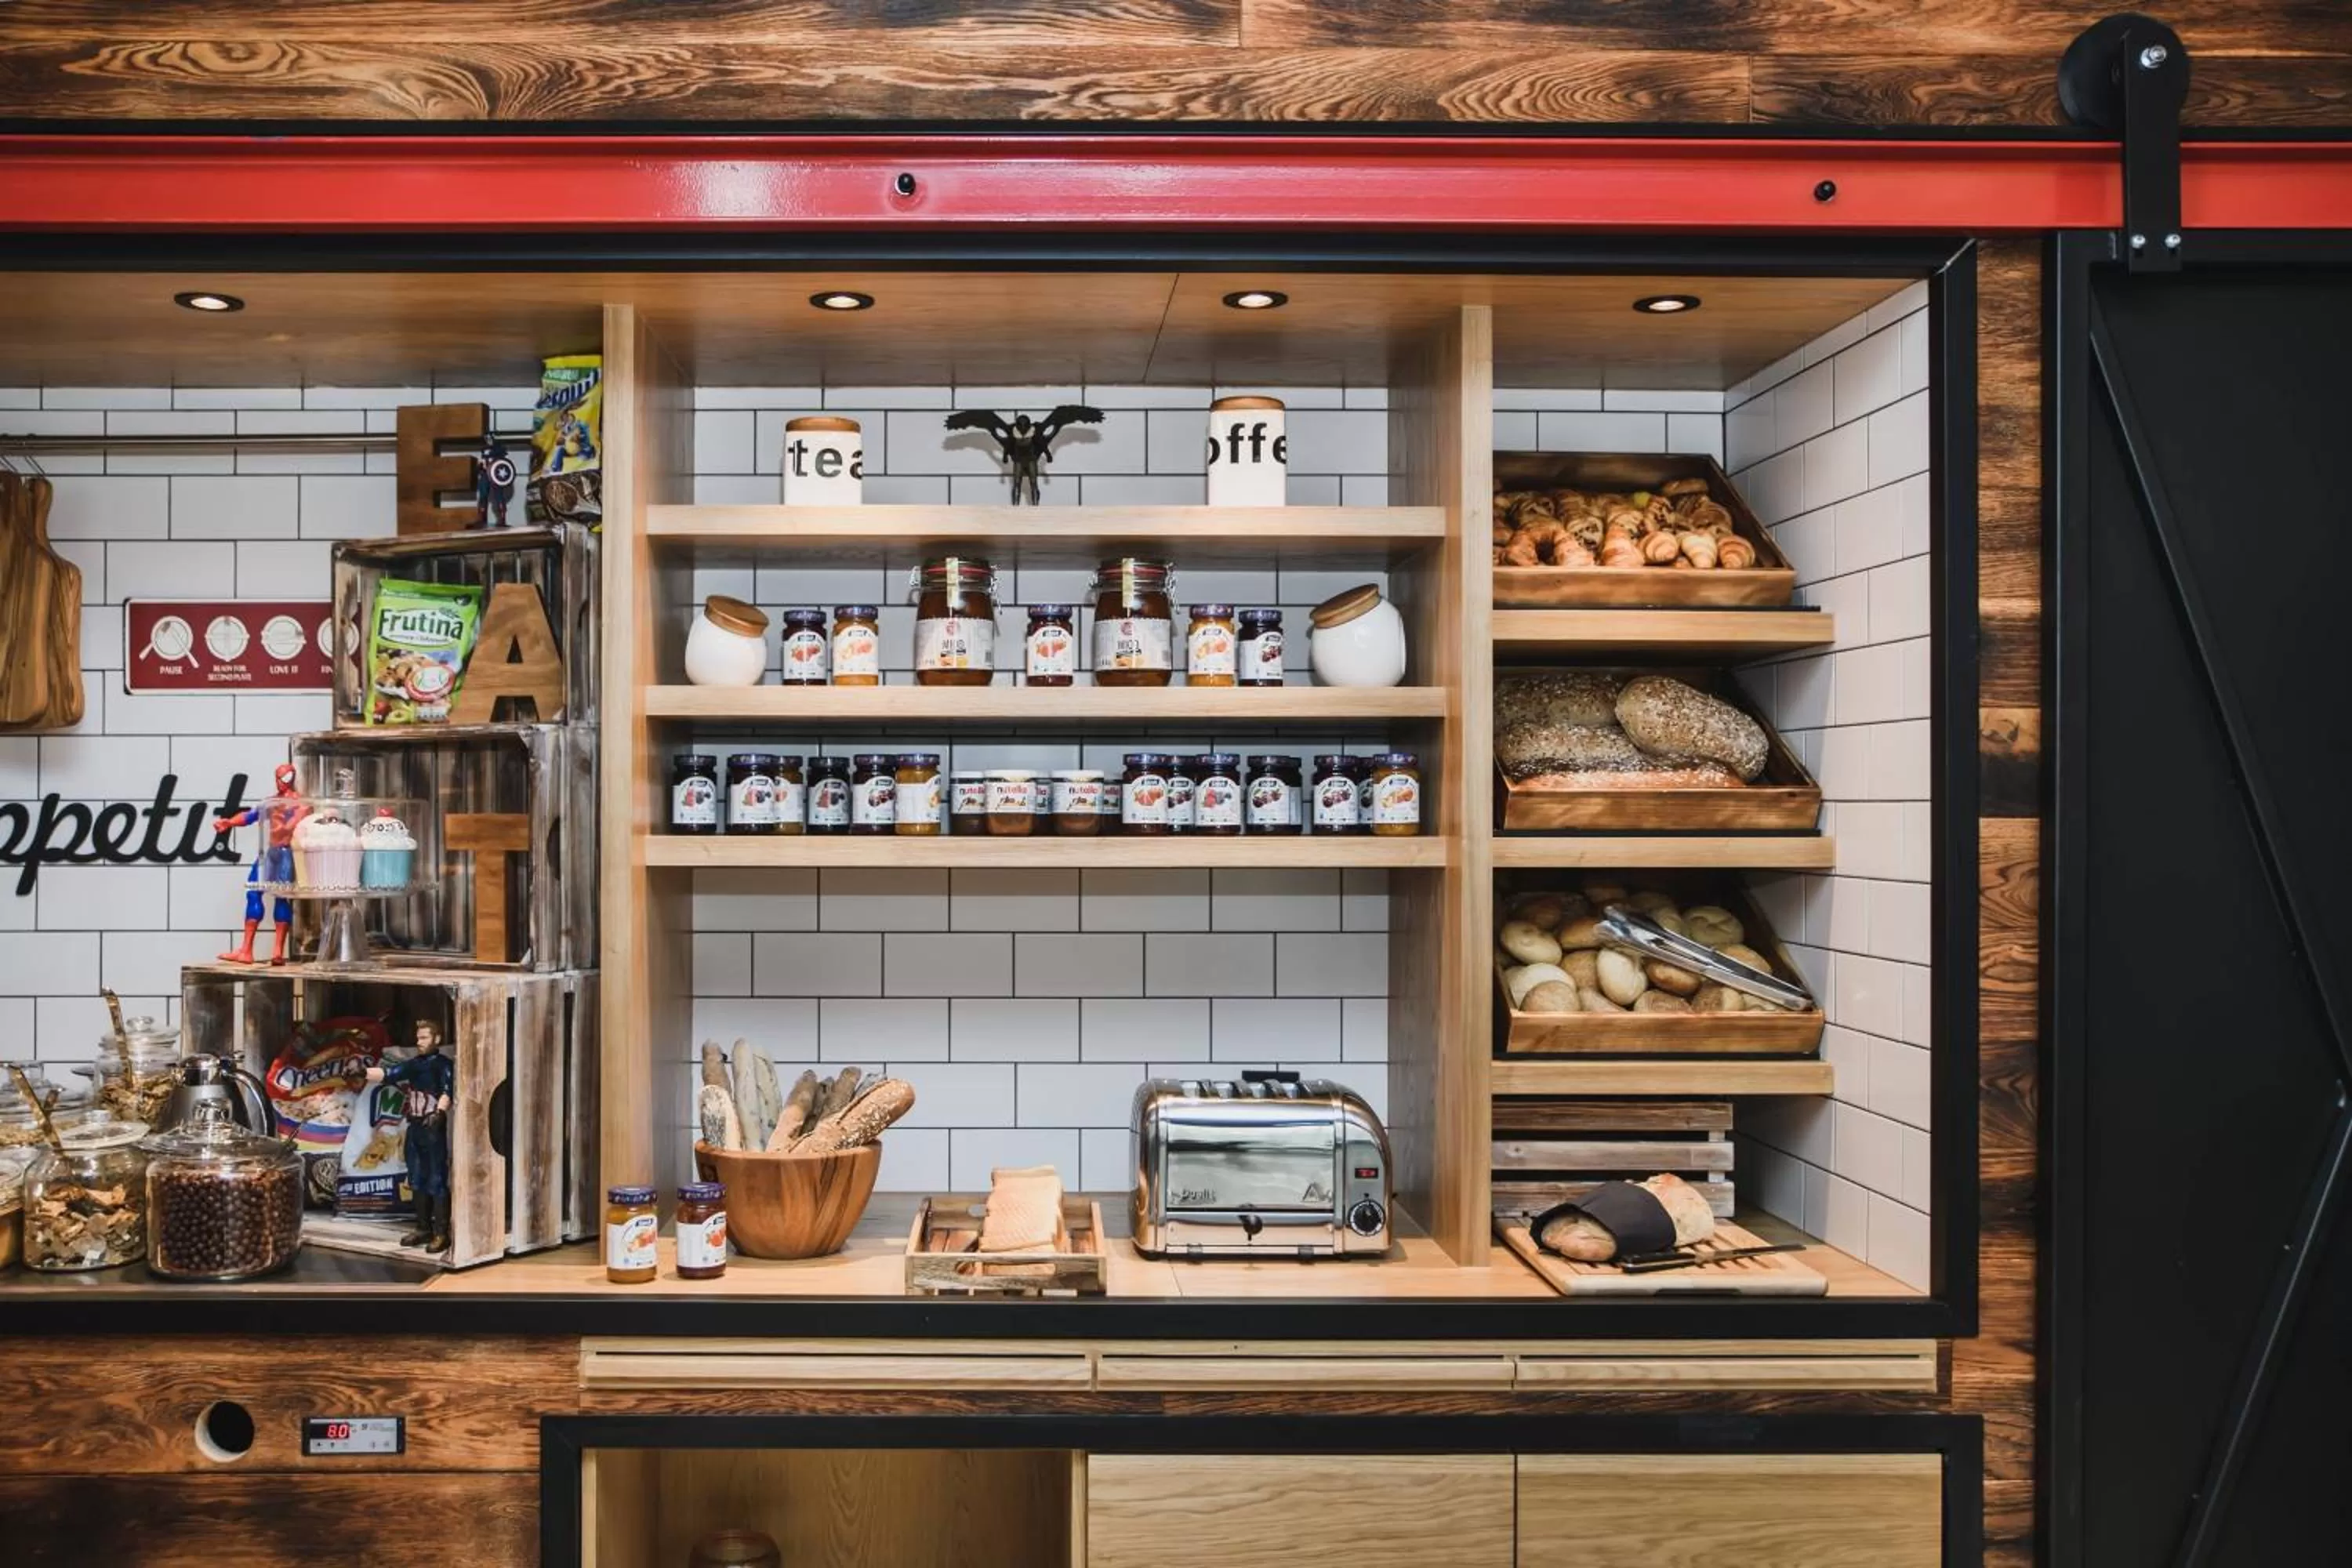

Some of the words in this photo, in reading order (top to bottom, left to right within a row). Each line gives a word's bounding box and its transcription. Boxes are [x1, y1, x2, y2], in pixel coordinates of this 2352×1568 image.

[397, 403, 489, 535] E
[377, 607, 464, 641] Frutina
[449, 583, 564, 724] A
[445, 812, 531, 964] T
[354, 1176, 394, 1196] EDITION
